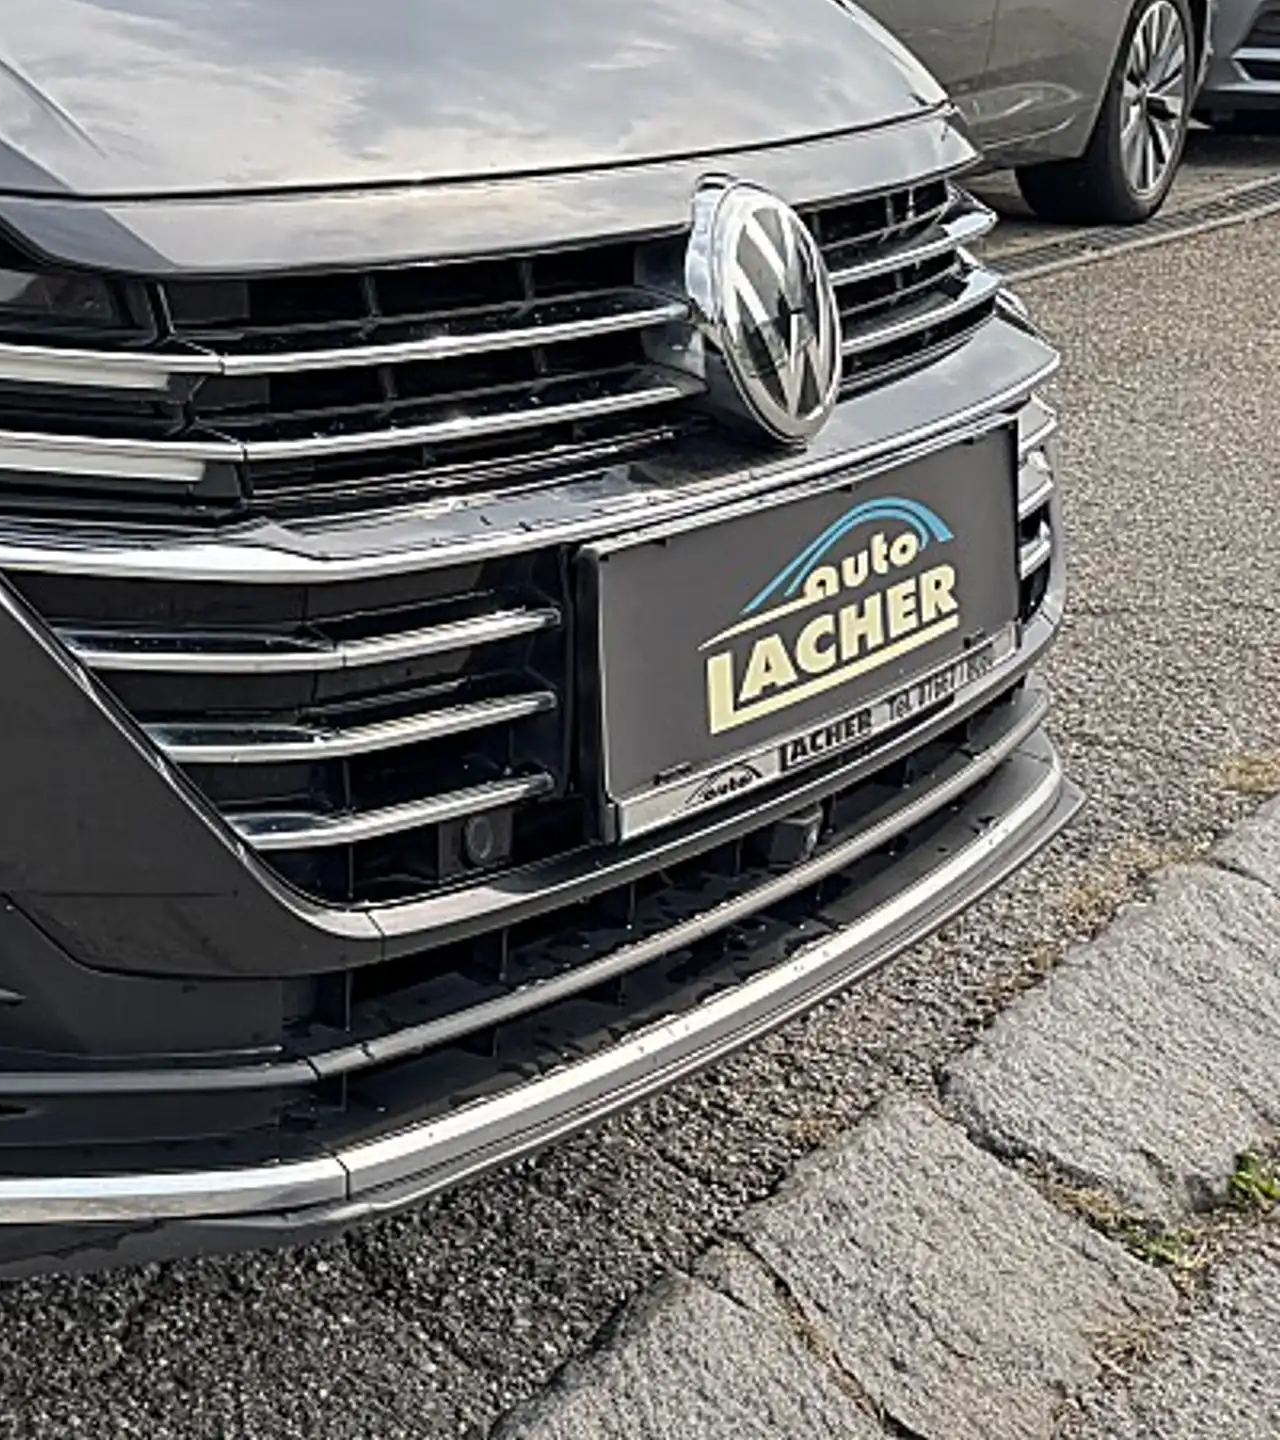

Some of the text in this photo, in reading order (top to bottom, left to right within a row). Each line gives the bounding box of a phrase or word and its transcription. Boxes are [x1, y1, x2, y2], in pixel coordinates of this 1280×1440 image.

[803, 532, 920, 600] auto
[706, 563, 959, 735] LACHER
[779, 708, 872, 773] LACHER
